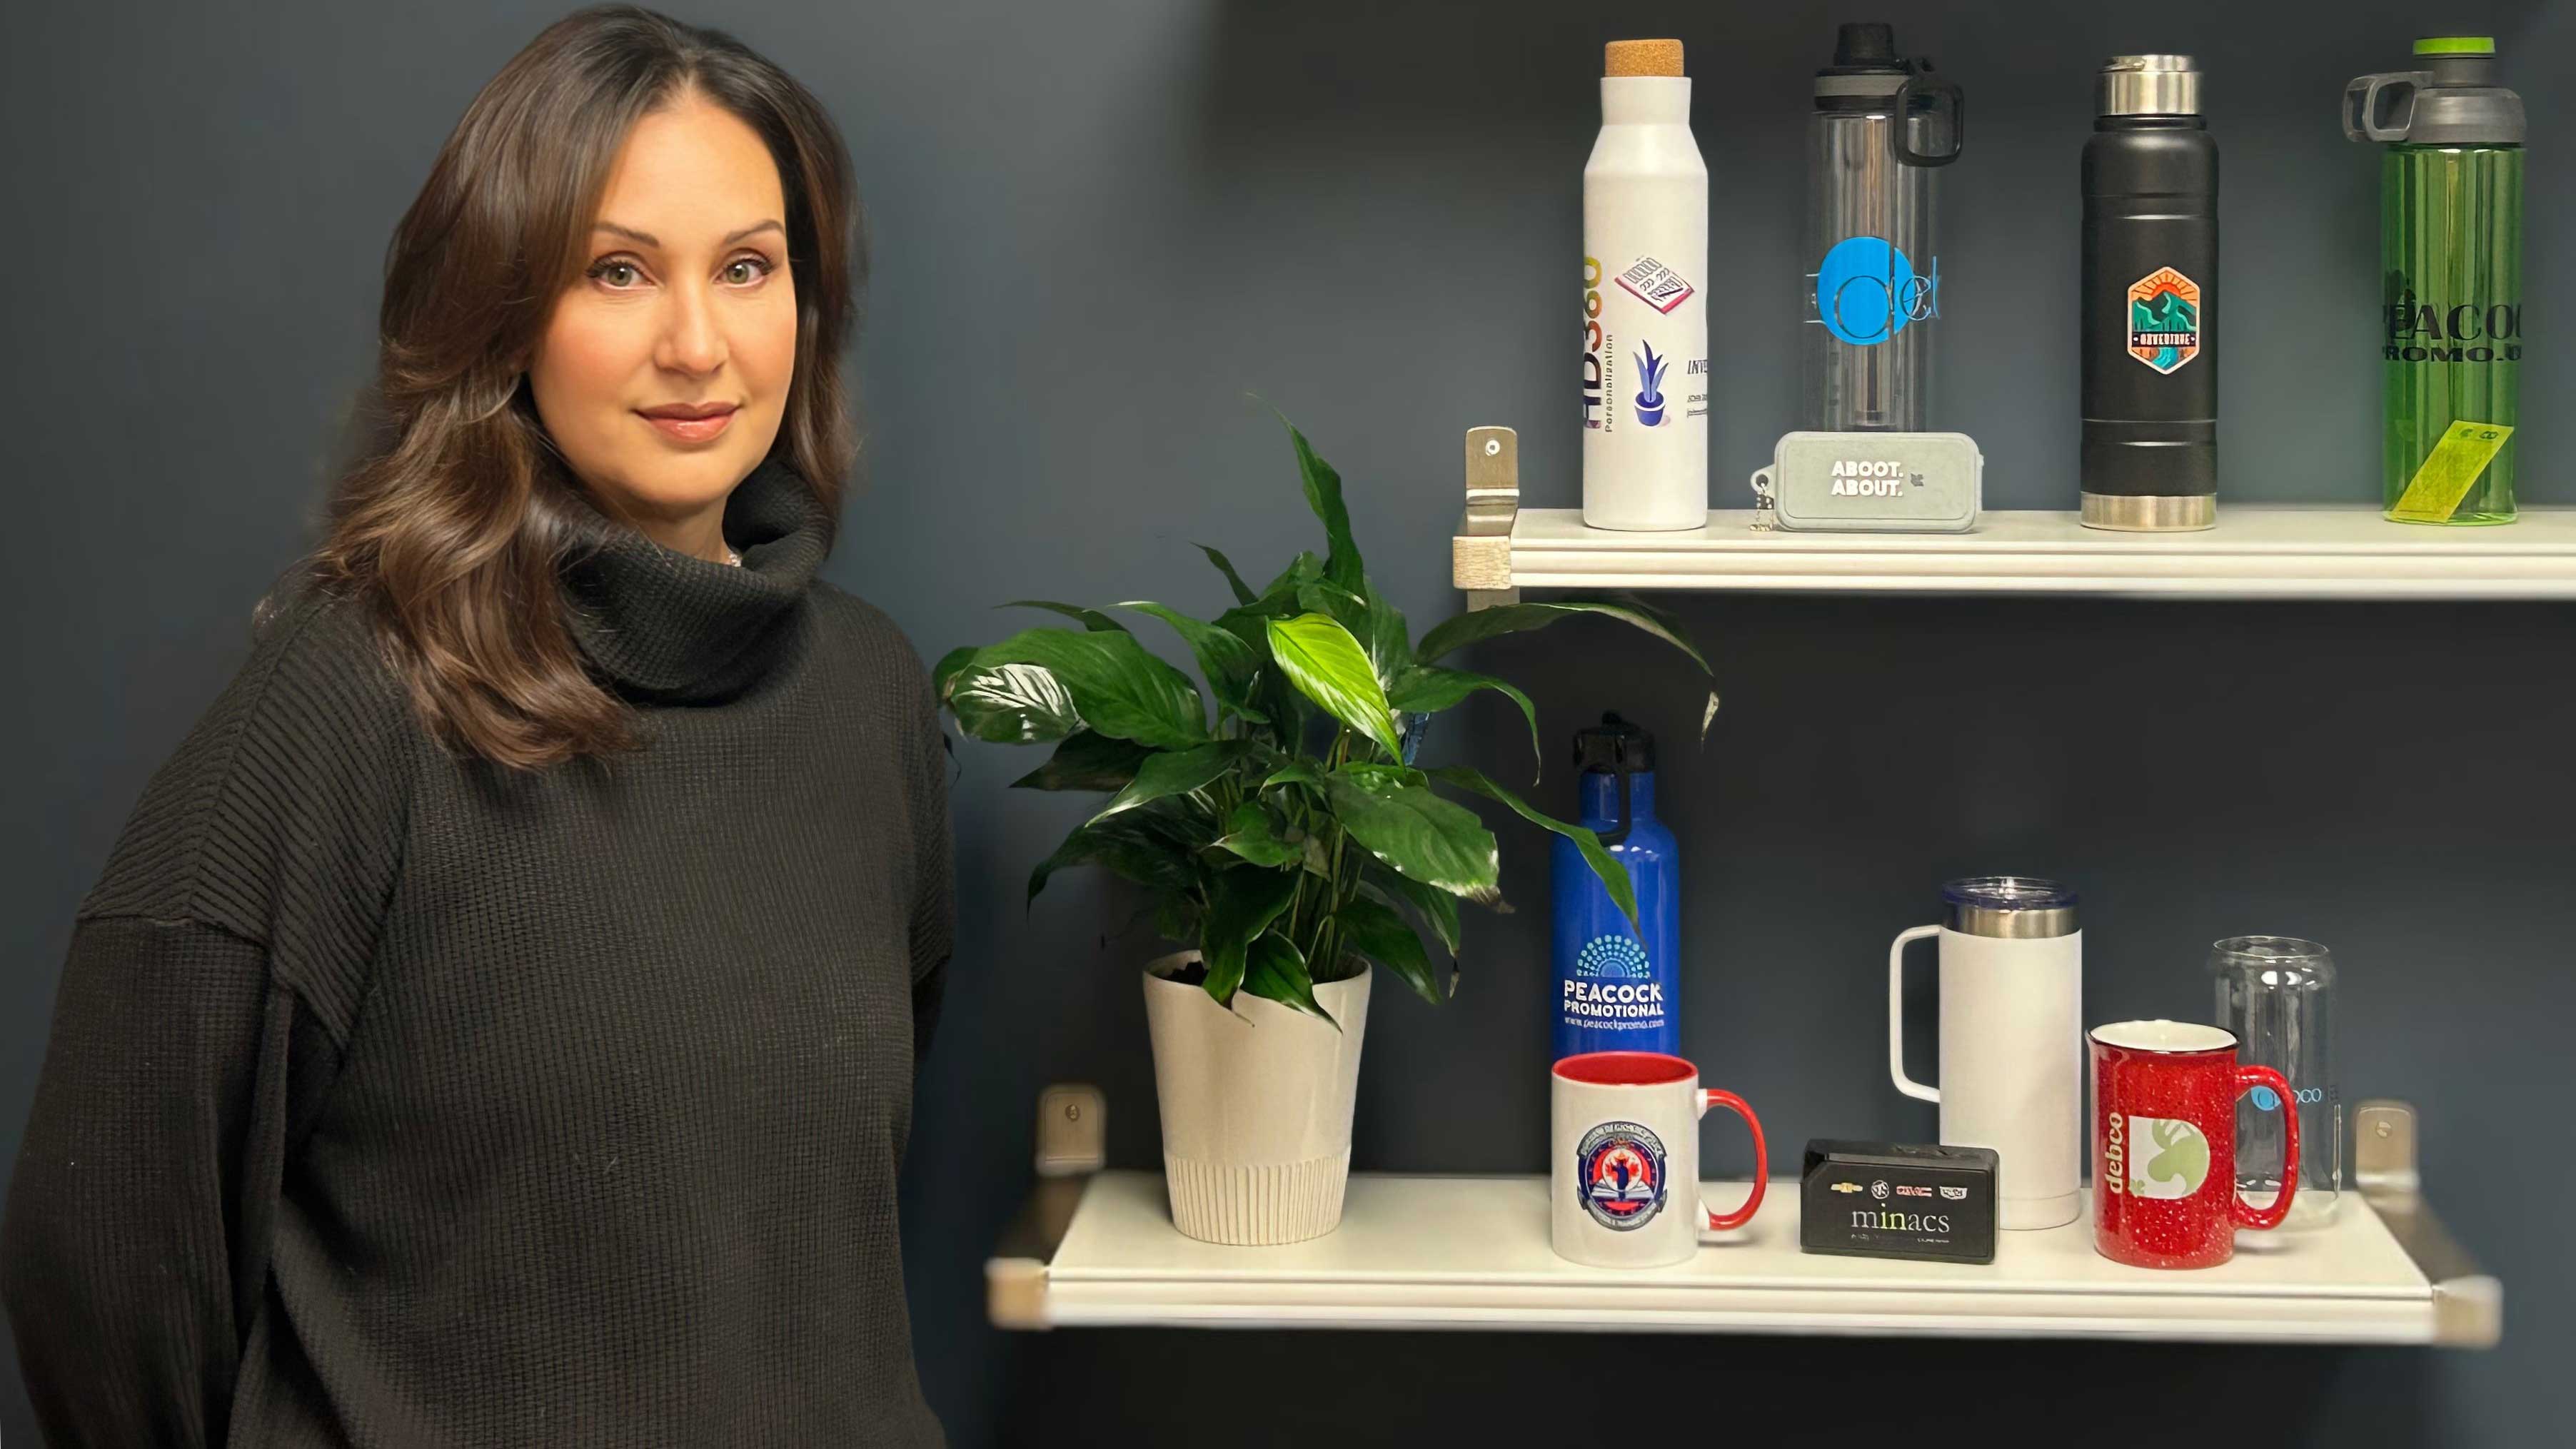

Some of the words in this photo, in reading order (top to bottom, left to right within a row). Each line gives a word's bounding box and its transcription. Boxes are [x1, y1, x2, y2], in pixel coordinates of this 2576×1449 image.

[1583, 256, 1602, 428] HD360
[1831, 461, 1904, 478] ABOOT.
[1831, 479, 1904, 498] ABOUT.
[1564, 980, 1664, 1004] PEACOCK
[1564, 1000, 1664, 1018] PROMOTIONAL
[1564, 1017, 1664, 1031] www.peacockpromo.com
[2103, 1112, 2124, 1194] debco
[1851, 1202, 1951, 1233] minacs
